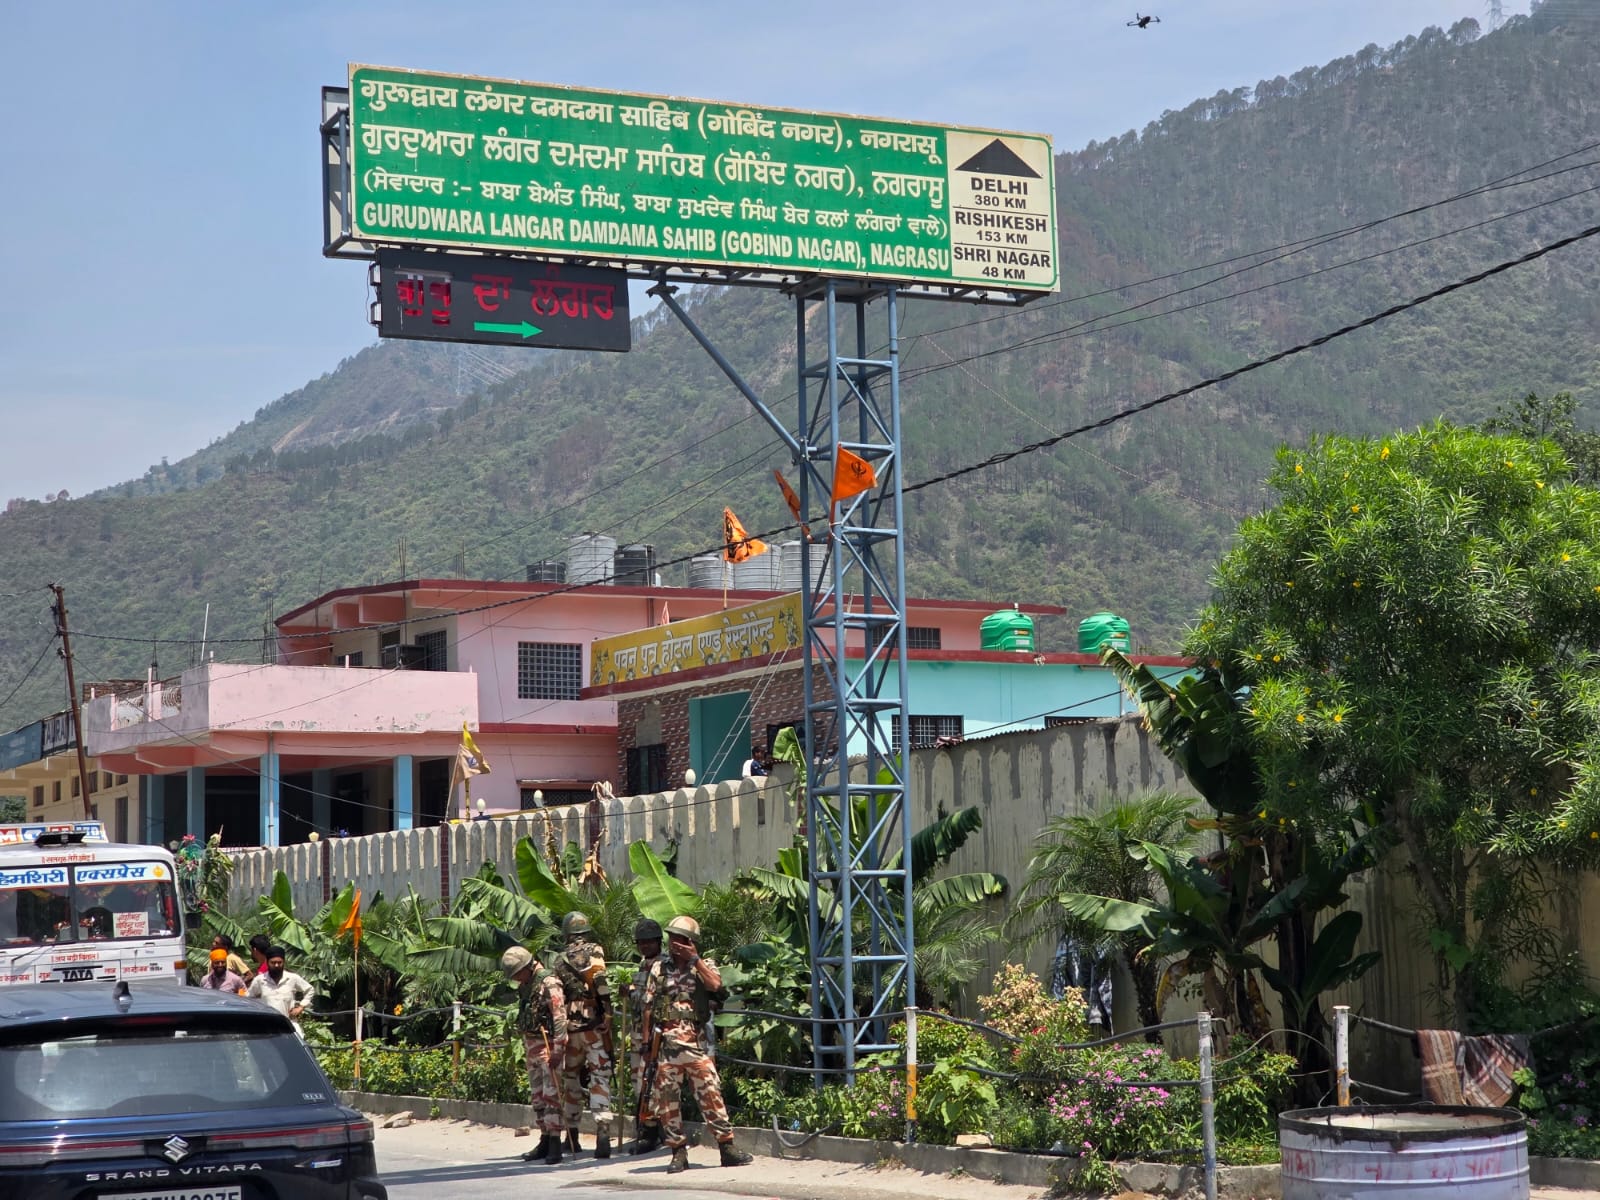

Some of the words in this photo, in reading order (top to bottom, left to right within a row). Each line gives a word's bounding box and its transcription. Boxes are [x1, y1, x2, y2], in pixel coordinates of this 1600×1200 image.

[360, 79, 458, 112] गुरूद्वारा
[464, 85, 526, 114] लंगर
[530, 97, 613, 123] दमदमा
[619, 101, 690, 131] साहिब
[698, 106, 776, 140] (गोबिंद
[782, 120, 853, 153] नगर),
[860, 129, 943, 164] नगरासू
[361, 124, 475, 158] ਗੁਰਦੁਆਰਾ
[482, 127, 541, 163] ਲੰਗਰ
[549, 141, 628, 171] ਦਮਦਮਾ
[636, 144, 706, 178] ਸਾਹਿਬ
[714, 147, 788, 185] (ਗੋਬਿੰਦ
[794, 164, 864, 198] ਨਗਰ),
[872, 171, 945, 209] ਨਗਰਾਸੂ
[970, 177, 1028, 195] DELHI
[363, 167, 445, 195] (ਸੇਵਾਦਾਰ
[480, 181, 521, 202] ਬਾਬਾ
[528, 180, 575, 206] ਬੇਅੰਤ
[581, 185, 626, 214] ਸਿੰਘ,
[633, 194, 672, 213] ਬਾਬਾ
[678, 195, 734, 219] ਸੁਖਦੇਵ
[740, 197, 777, 223] ਸਿੰਘ
[782, 202, 810, 225] ਬੇਰ
[815, 209, 849, 228] ਕਲਾਂ
[855, 208, 902, 232] ਲੰਗਰਾਂ
[907, 214, 948, 240] ਵਾਲੇ)
[975, 194, 1000, 207] 380
[1004, 197, 1026, 209] KM
[955, 211, 1047, 232] RISHIKESH
[363, 202, 485, 235] GURUDWARA
[490, 212, 565, 241] LANGAR
[570, 219, 659, 248] DAMDAMA
[663, 226, 716, 252] SAHIB
[722, 229, 793, 259] (GOBIND
[798, 238, 867, 270] NAGAR),
[871, 243, 949, 271] NAGRASU
[976, 230, 1001, 242] 153
[1006, 233, 1028, 244] KM
[954, 246, 991, 262] SHRI
[997, 251, 1050, 268] NAGAR
[982, 266, 999, 278] 48
[1004, 268, 1026, 280] KM
[472, 274, 513, 312] ਦਾ
[530, 266, 616, 321] ਲੰਗਰ
[614, 646, 638, 670] पवन
[641, 642, 658, 674] पुत्र
[662, 630, 694, 666] होटल
[77, 864, 148, 882] एक्सप्रेस
[62, 969, 93, 980] TATA
[86, 1169, 170, 1181] GRAND
[179, 1163, 263, 1175] VITARA
